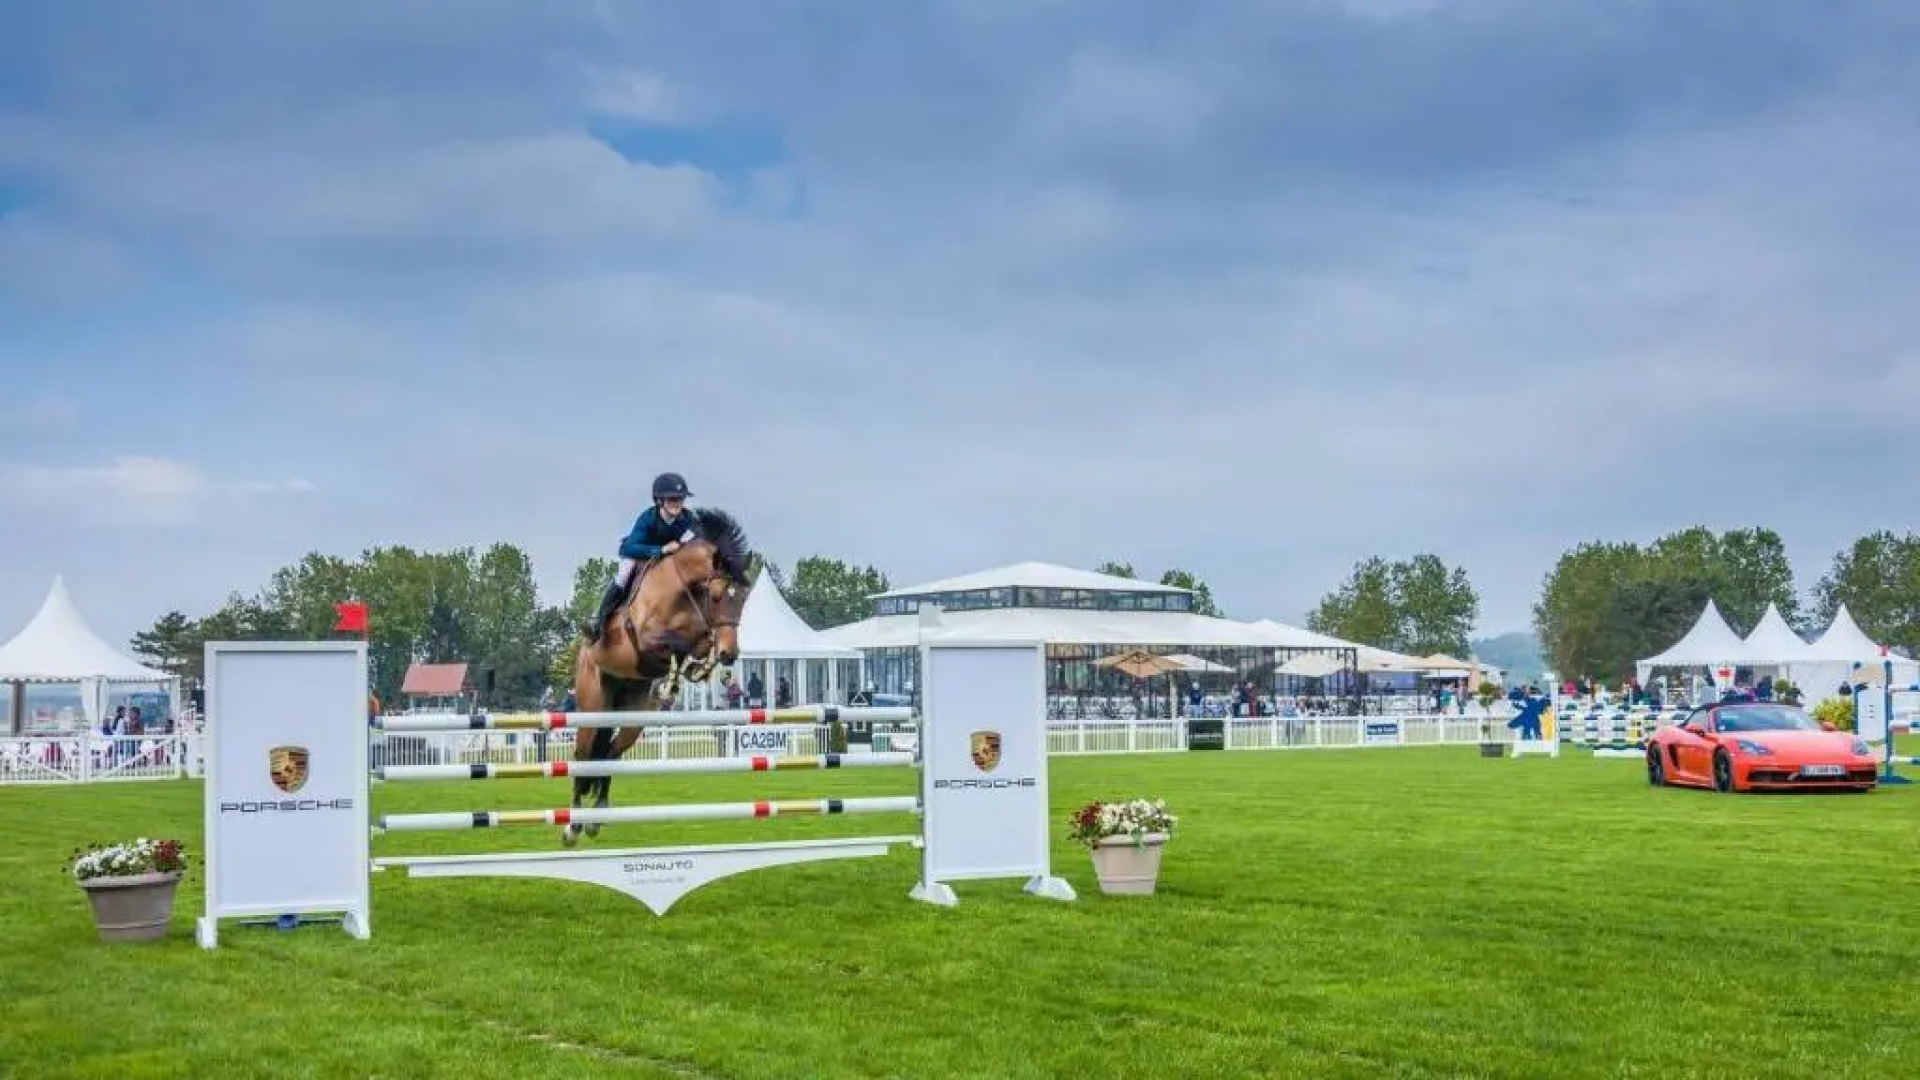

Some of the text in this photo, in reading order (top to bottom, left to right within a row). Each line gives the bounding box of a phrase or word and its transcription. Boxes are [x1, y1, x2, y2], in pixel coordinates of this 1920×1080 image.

[741, 732, 786, 748] CA2BM
[934, 778, 1035, 788] PORSCHE
[221, 799, 353, 812] PORSCHE
[623, 861, 693, 872] SONAUTO
